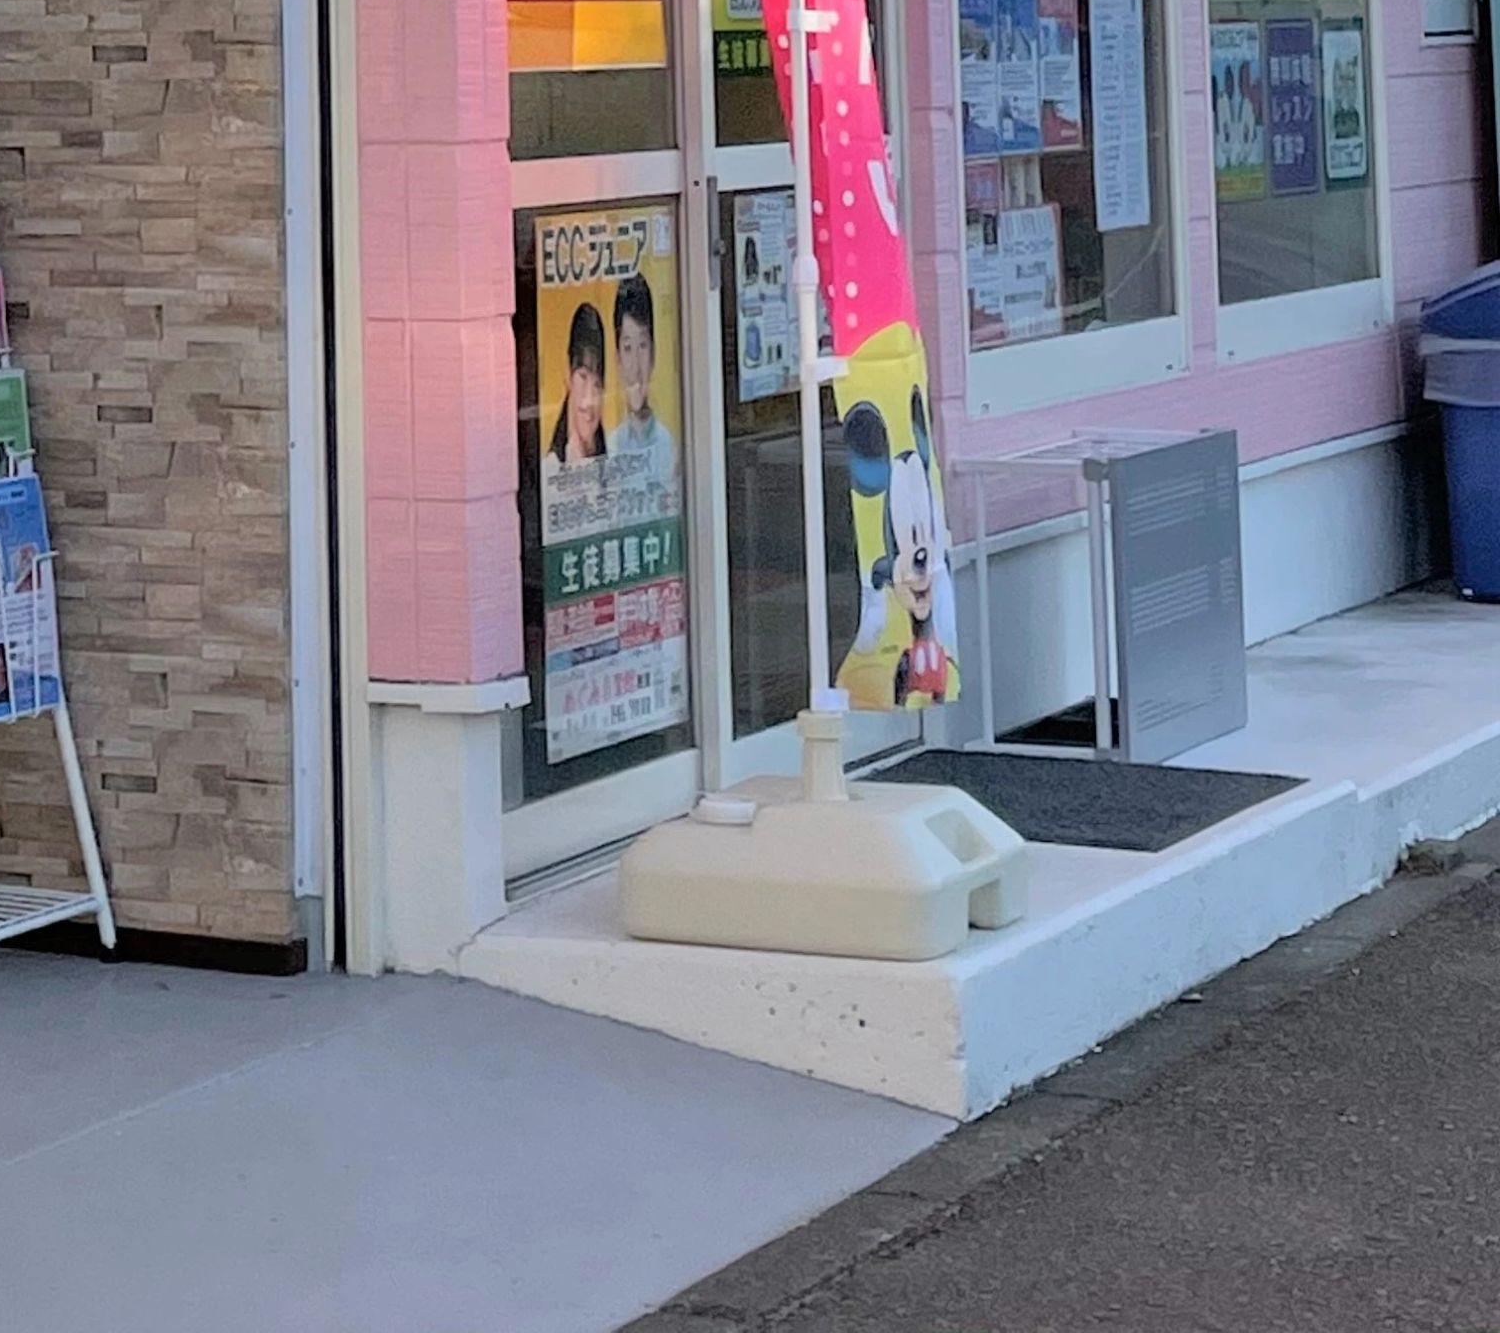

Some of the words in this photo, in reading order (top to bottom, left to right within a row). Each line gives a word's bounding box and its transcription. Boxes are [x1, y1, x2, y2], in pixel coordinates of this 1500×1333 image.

[542, 221, 646, 282] ECCジュニア
[561, 530, 671, 593] 生徒募集中!
